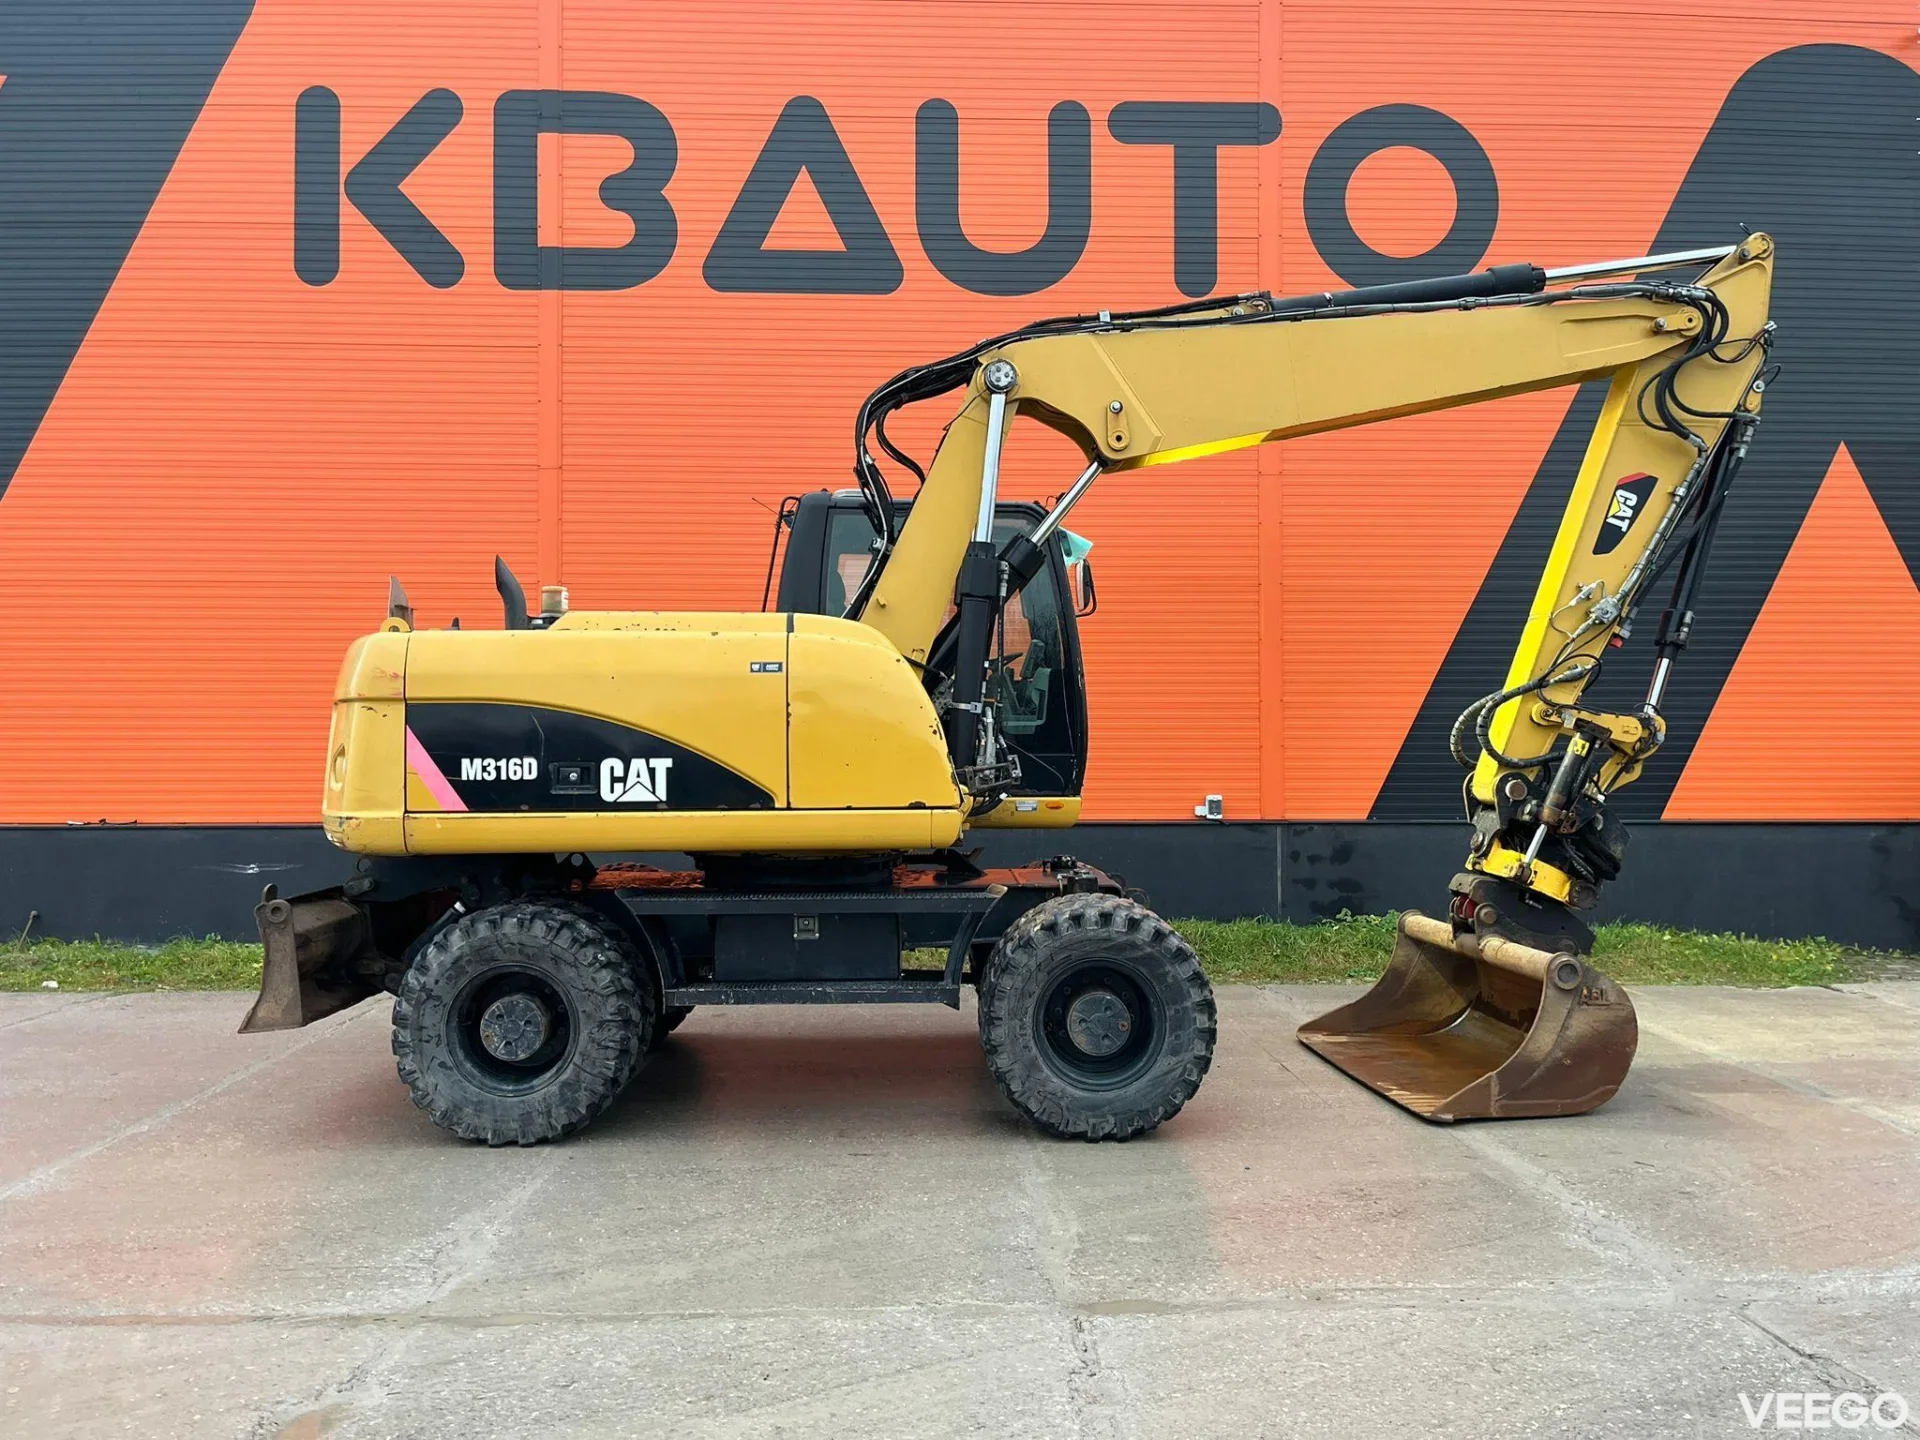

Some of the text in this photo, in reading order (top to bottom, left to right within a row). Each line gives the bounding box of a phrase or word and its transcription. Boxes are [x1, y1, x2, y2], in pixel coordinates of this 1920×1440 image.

[1606, 489, 1638, 532] CAT
[461, 757, 539, 781] M316D
[600, 757, 673, 803] CAT
